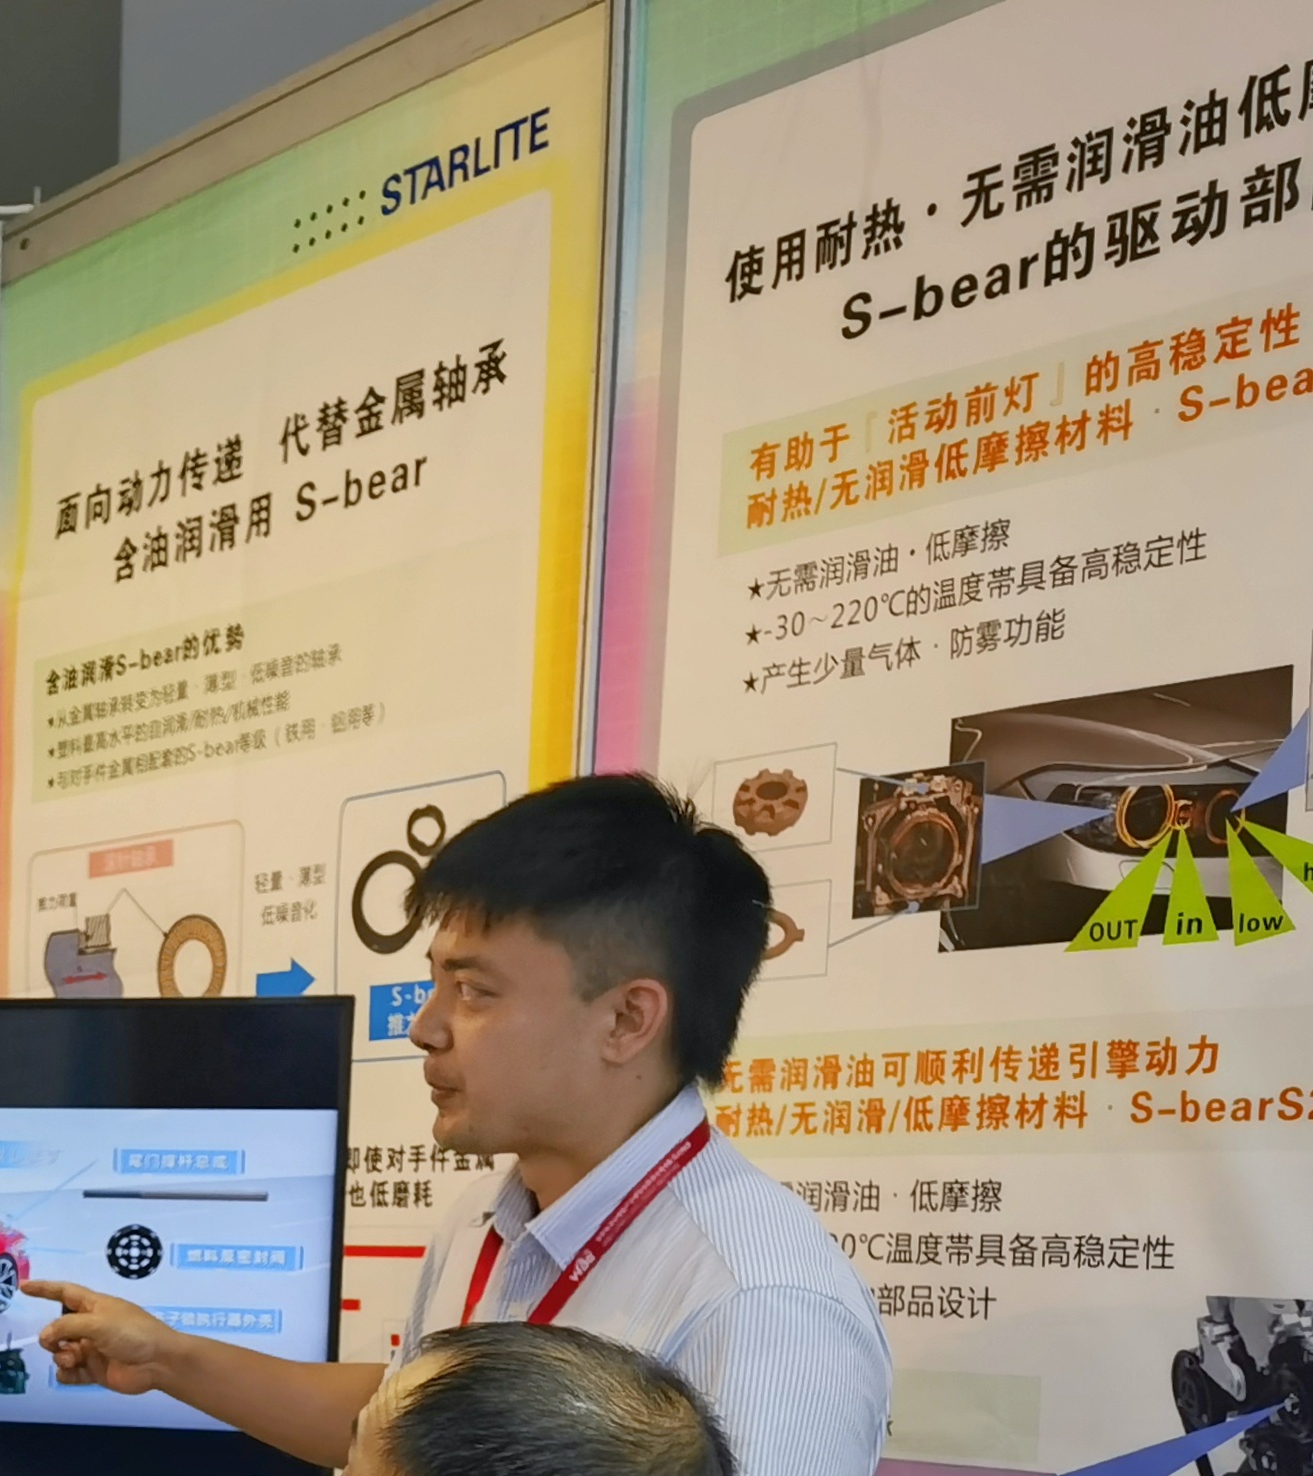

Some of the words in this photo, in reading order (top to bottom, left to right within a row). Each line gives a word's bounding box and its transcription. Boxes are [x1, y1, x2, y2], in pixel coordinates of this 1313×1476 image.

[380, 107, 551, 216] STARLITE
[725, 59, 1313, 304] 使用耐热·无需润滑油低
[840, 156, 1313, 340] S-bear的驱动部
[55, 434, 246, 541] 面向动力传递
[279, 338, 508, 465] 代替金属轴承
[113, 491, 273, 584] 含油润滑用
[295, 456, 429, 523] S-bear
[1089, 919, 1138, 942] OUT
[1176, 912, 1203, 935] in
[1239, 913, 1284, 934] low
